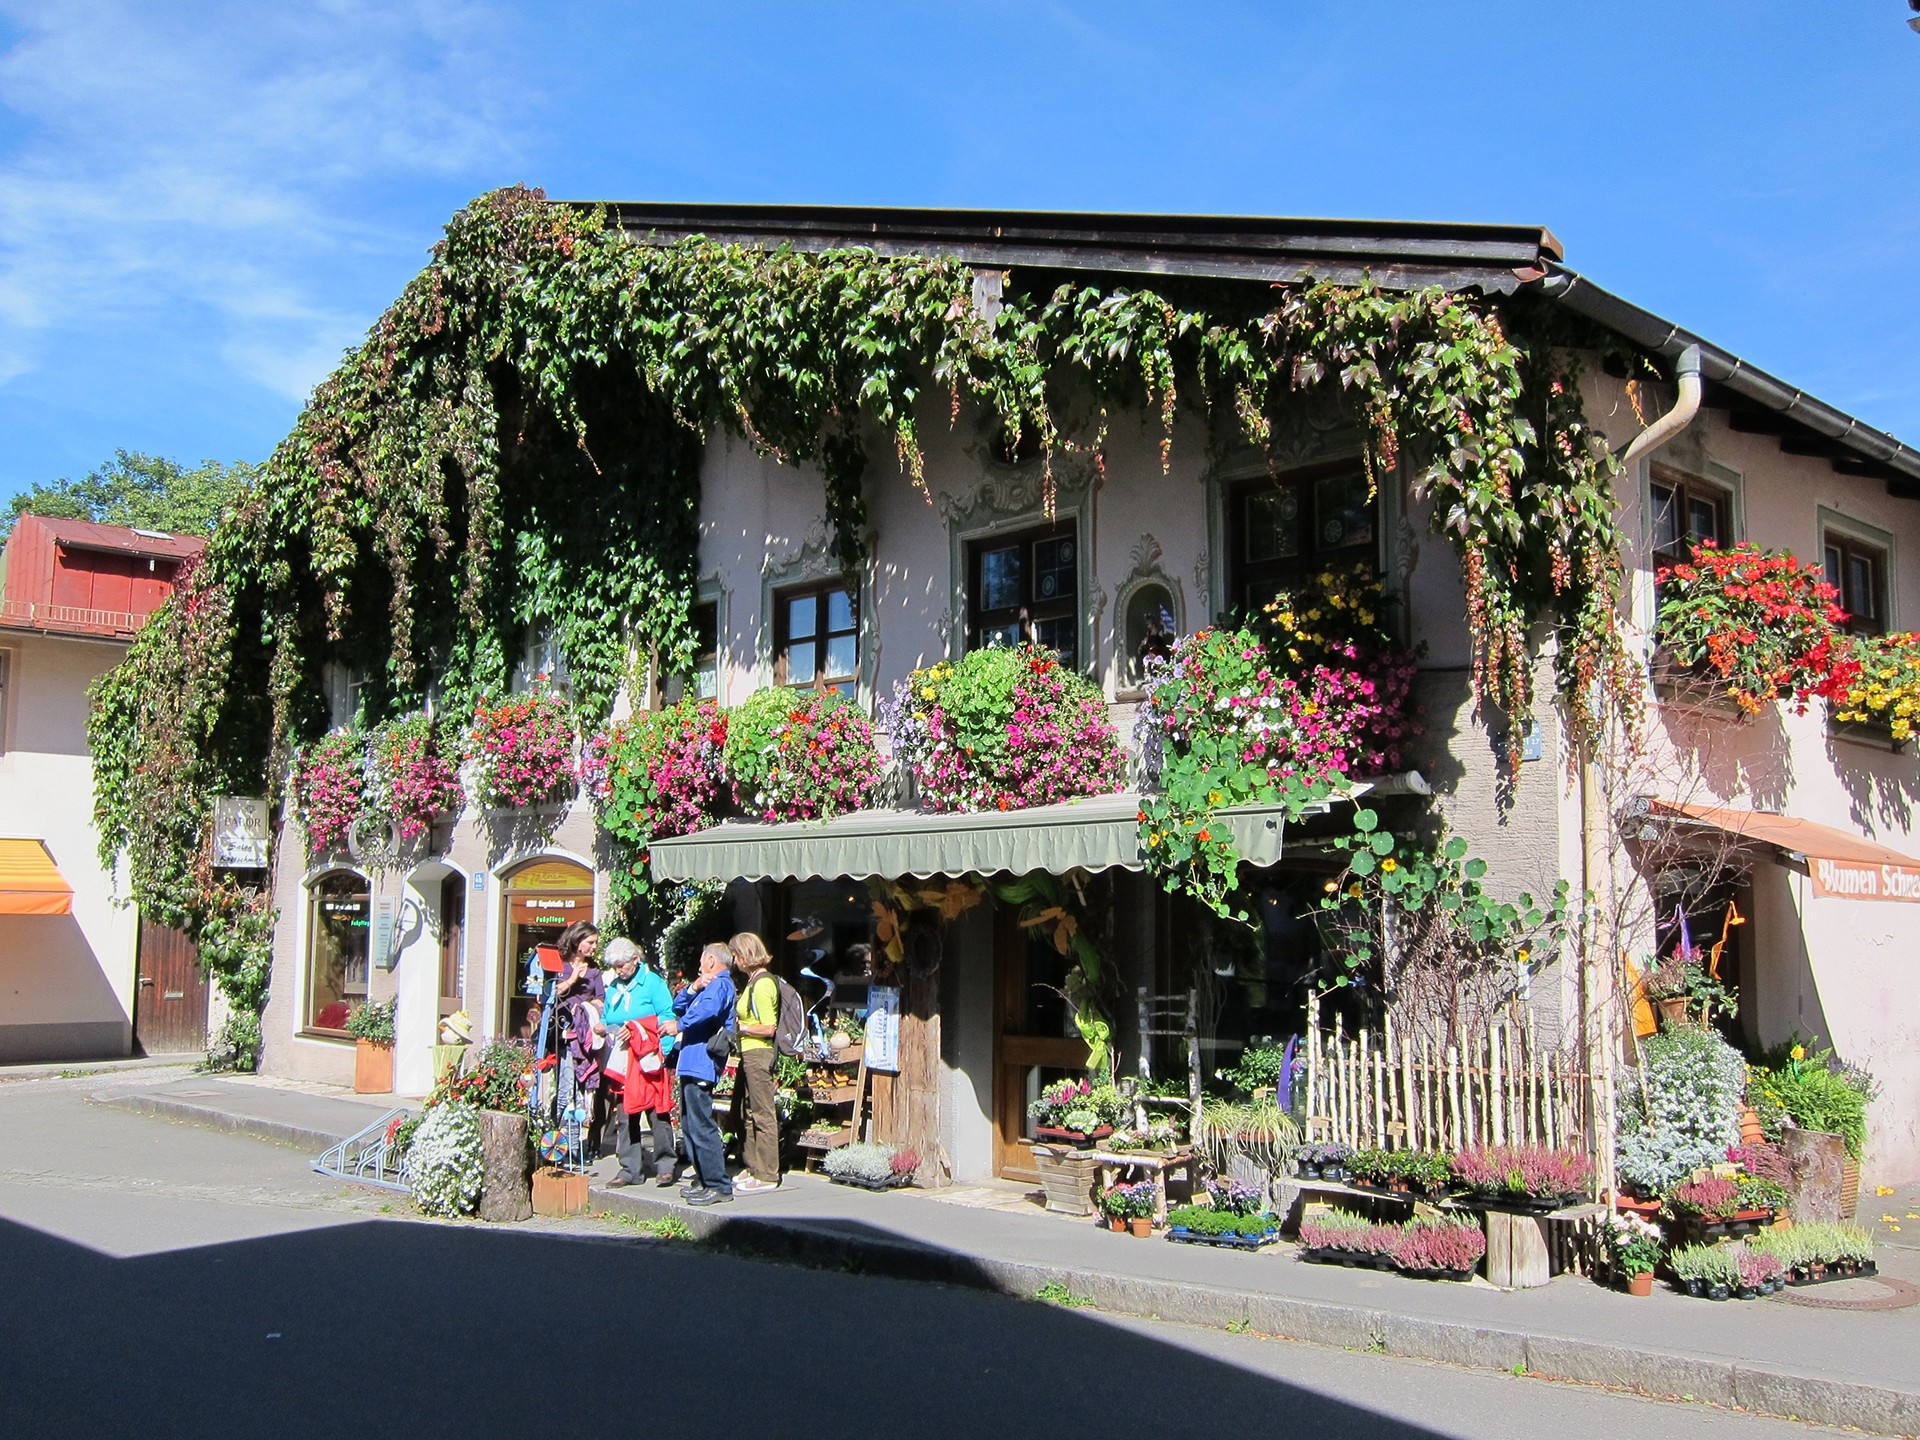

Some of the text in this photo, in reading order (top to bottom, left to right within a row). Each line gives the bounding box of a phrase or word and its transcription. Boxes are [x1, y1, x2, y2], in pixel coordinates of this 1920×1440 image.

[224, 817, 261, 827] BABOR
[1818, 859, 1877, 895] Blumen
[536, 916, 565, 924] Fußpflege
